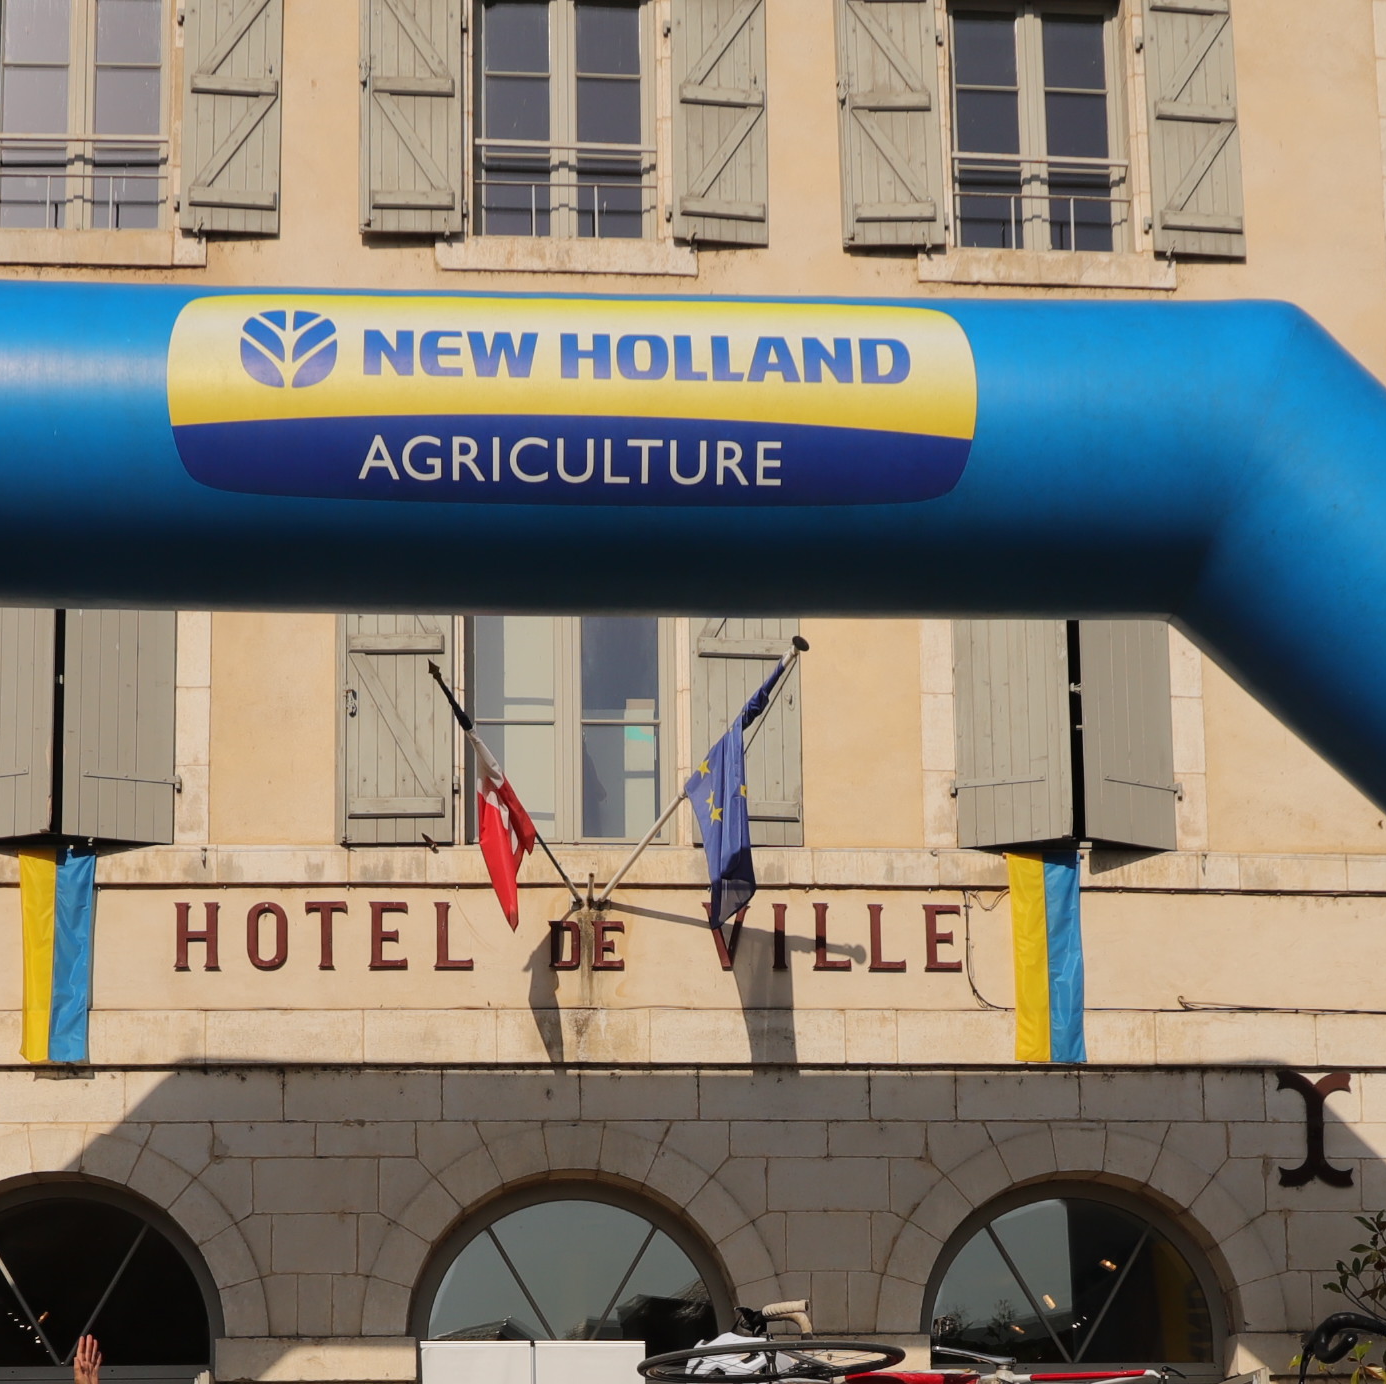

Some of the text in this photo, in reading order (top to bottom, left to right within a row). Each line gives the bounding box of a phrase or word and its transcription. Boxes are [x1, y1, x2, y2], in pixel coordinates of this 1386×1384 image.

[363, 328, 912, 385] NEW HOLLAND
[358, 434, 783, 487] AGRICULTURE
[172, 901, 964, 974] HOTEL DE VILLE
